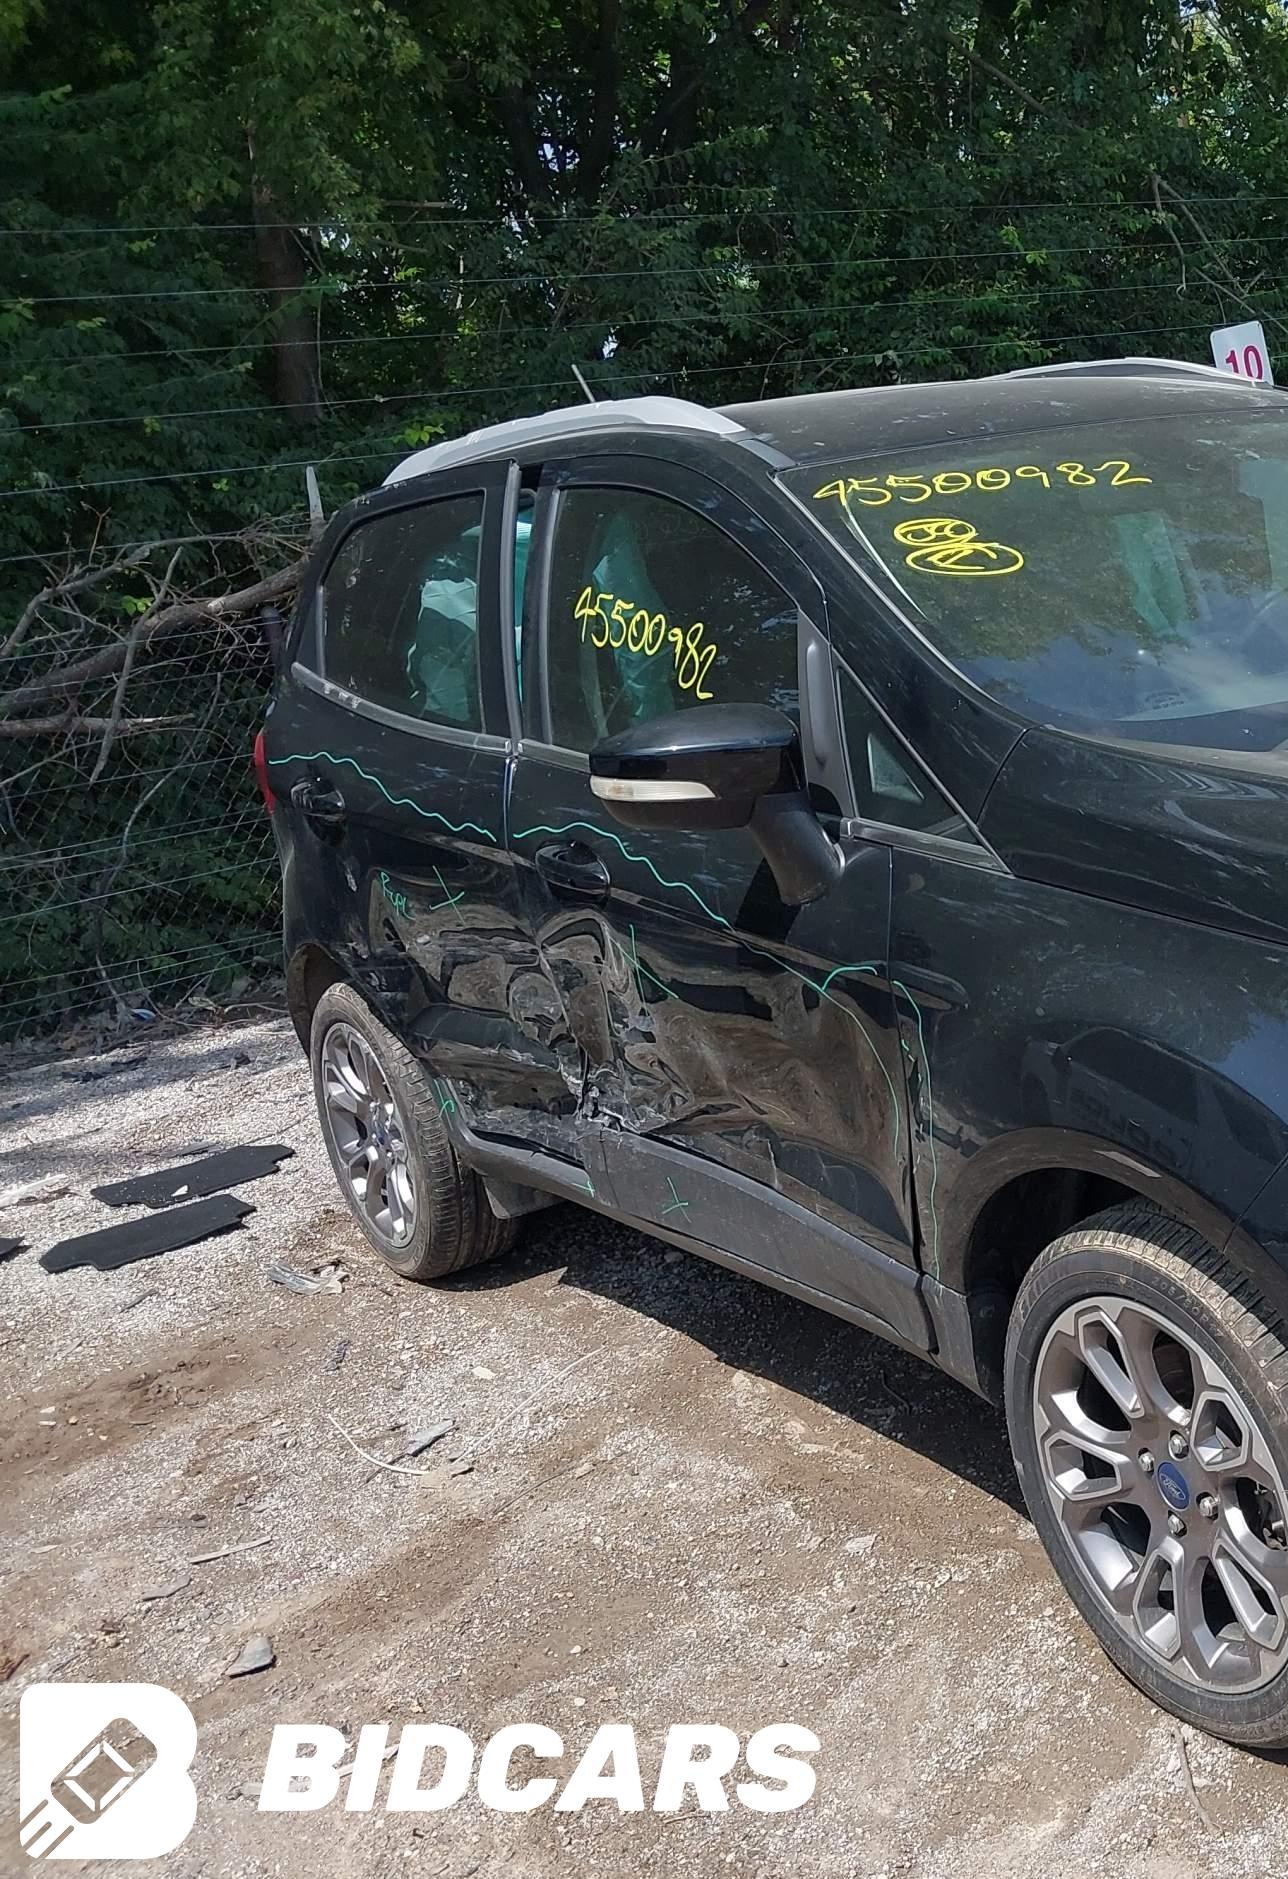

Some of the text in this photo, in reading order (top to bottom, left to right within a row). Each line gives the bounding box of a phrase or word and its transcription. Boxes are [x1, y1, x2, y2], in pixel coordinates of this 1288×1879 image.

[1225, 344, 1264, 380] 10
[812, 460, 1153, 507] 45500982
[574, 585, 718, 700] 45500982
